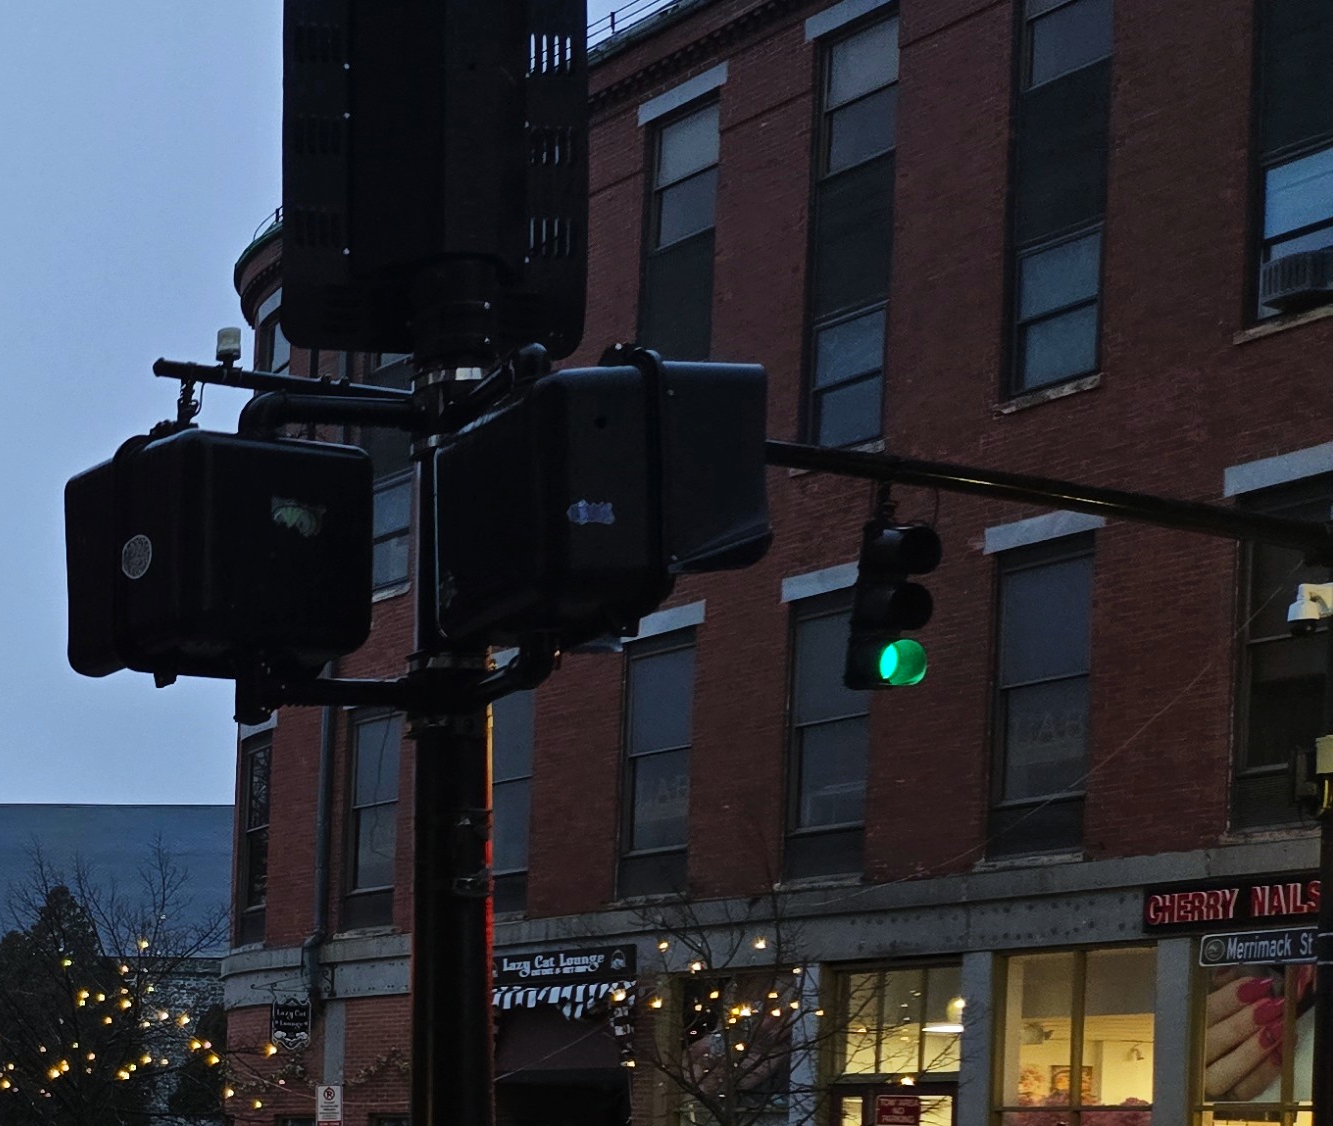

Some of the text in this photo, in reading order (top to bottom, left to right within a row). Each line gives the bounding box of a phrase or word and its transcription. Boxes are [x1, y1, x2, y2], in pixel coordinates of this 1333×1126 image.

[1146, 880, 1322, 925] CHERRY NAILS
[1226, 932, 1314, 960] Merrimack St
[503, 958, 531, 978] Lazy
[534, 955, 555, 969] Cat
[559, 953, 605, 972] Lounge
[277, 1009, 294, 1020] Lazy
[882, 1114, 915, 1124] PARKING
[893, 1106, 905, 1115] NO
